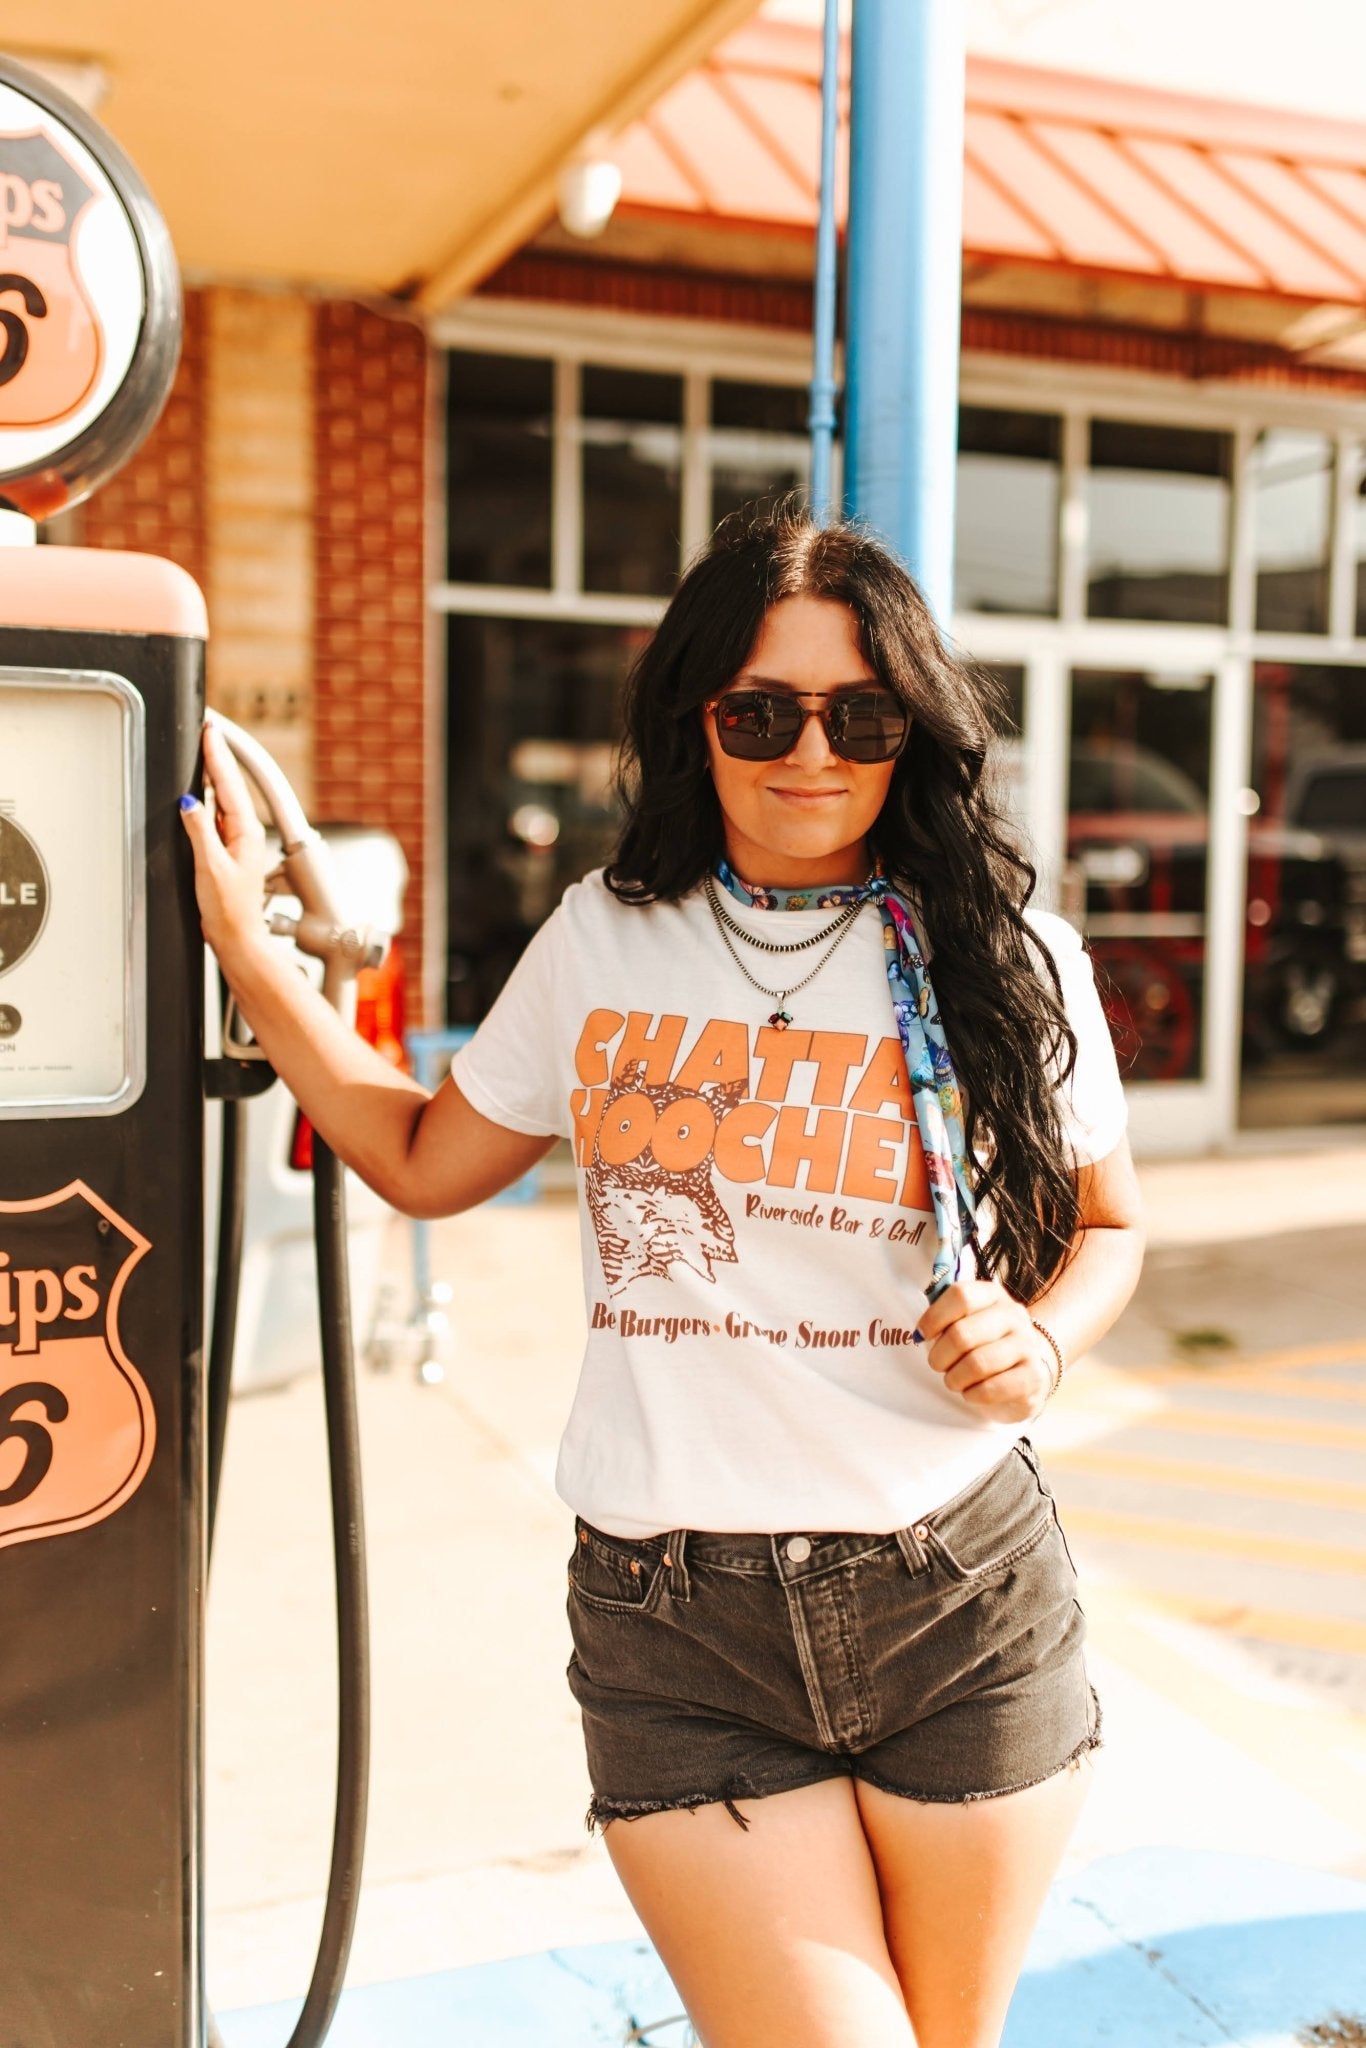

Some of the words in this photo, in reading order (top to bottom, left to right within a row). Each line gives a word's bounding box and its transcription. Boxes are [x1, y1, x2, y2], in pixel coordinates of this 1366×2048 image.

[574, 1008, 919, 1121] CHATTA
[745, 1192, 824, 1229] Riverside
[830, 1206, 864, 1235] Bar
[869, 1217, 885, 1239] &
[888, 1219, 928, 1247] Grill
[620, 1309, 712, 1345] Burgers
[795, 1320, 861, 1349] Snow
[868, 1318, 920, 1348] Cone
[0, 1381, 69, 1507] 6
